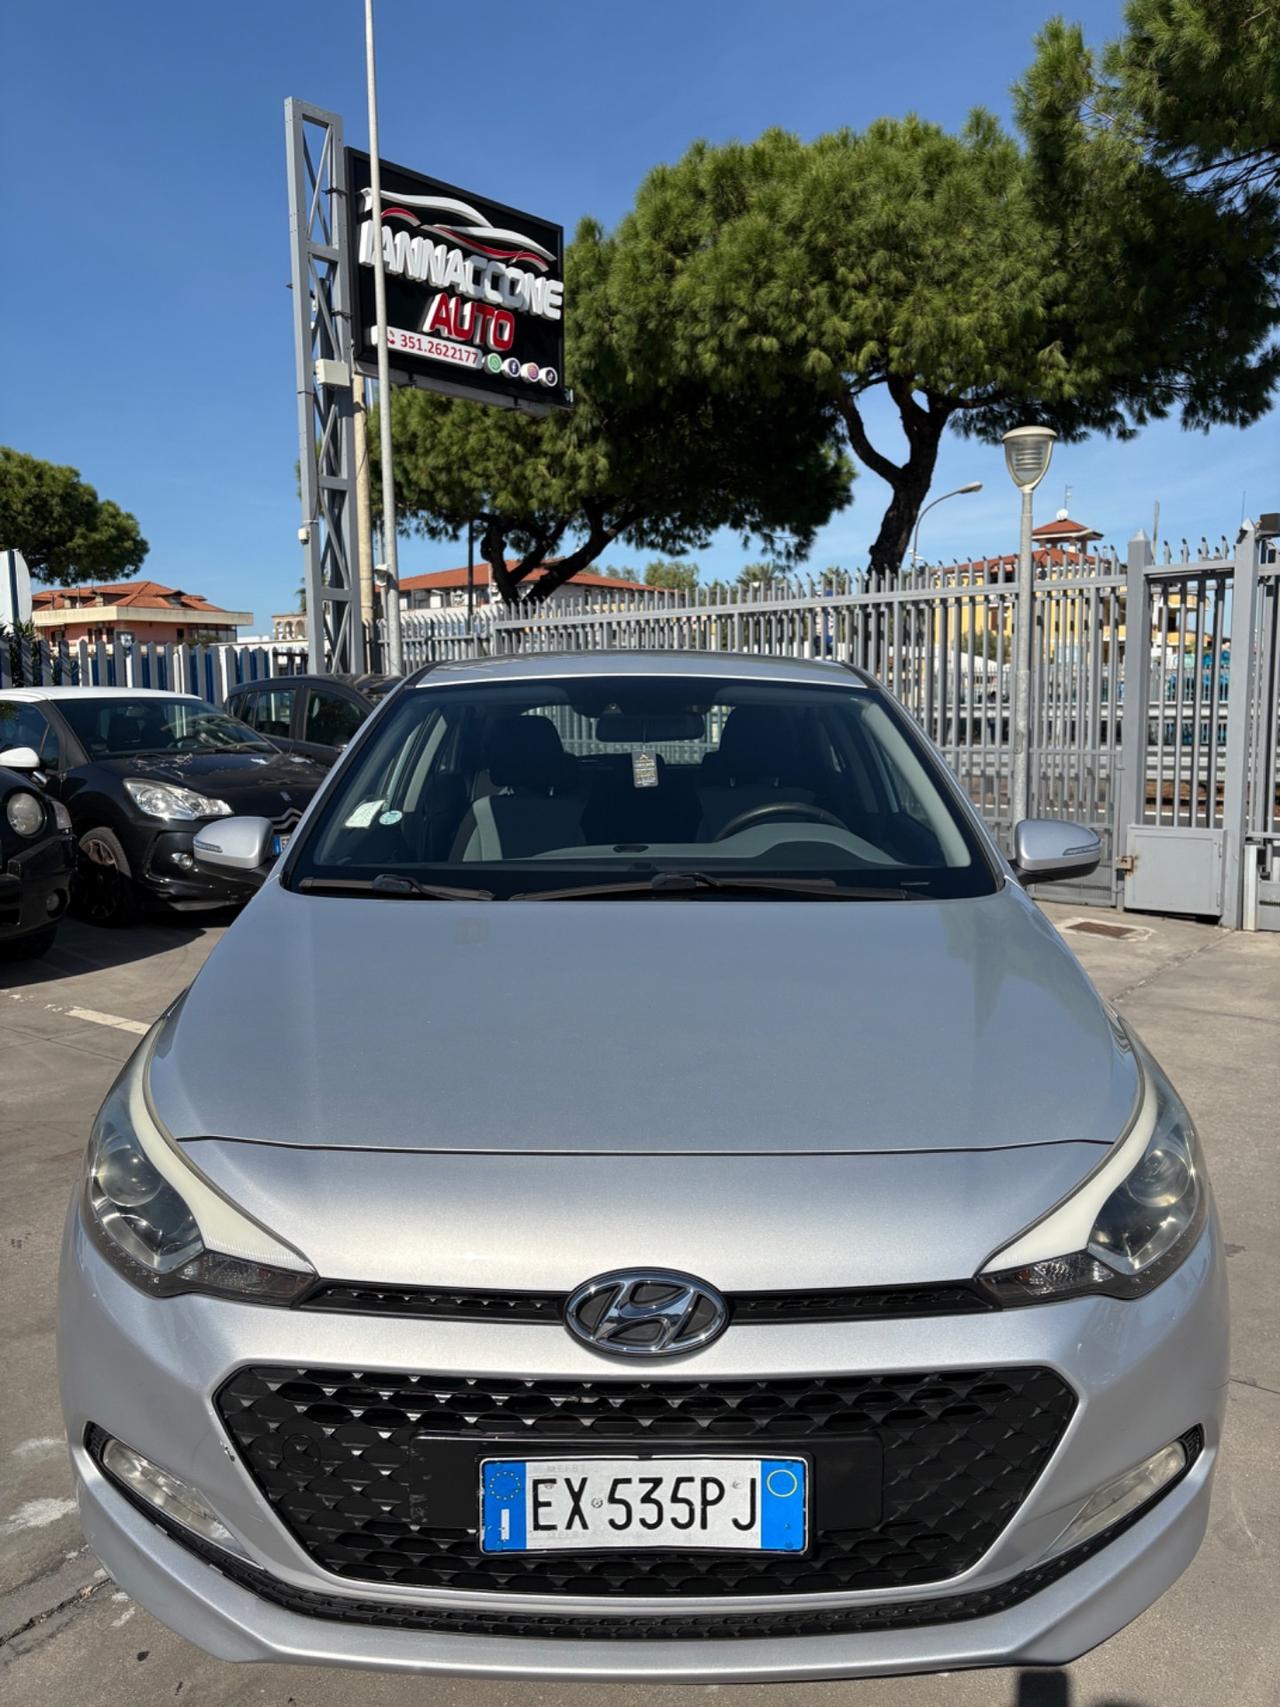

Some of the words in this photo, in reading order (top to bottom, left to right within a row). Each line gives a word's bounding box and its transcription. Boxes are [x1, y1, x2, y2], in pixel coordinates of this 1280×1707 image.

[359, 220, 563, 320] IANNACCONE
[401, 334, 479, 364] 351.2622177
[424, 293, 515, 351] AUTO
[532, 1477, 590, 1531] EX
[607, 1476, 757, 1532] 535PJ
